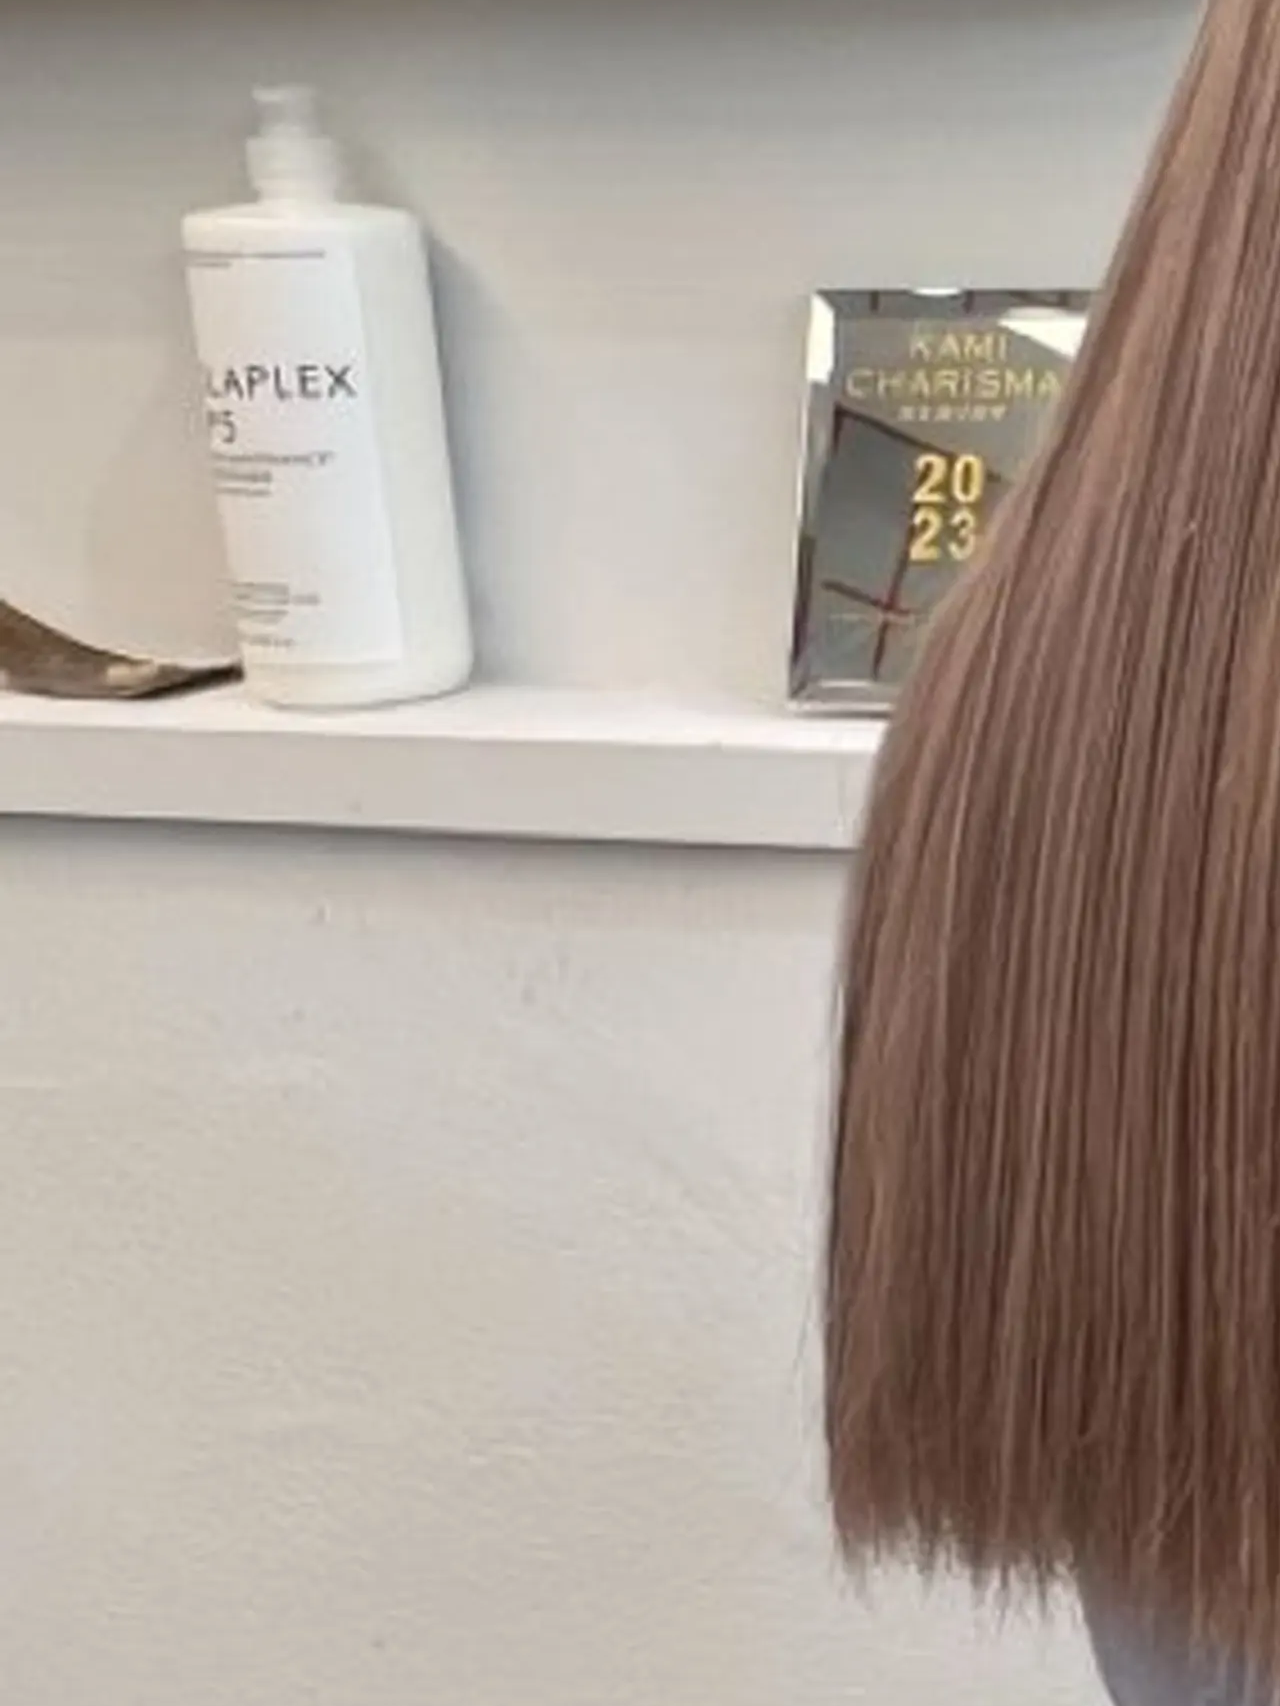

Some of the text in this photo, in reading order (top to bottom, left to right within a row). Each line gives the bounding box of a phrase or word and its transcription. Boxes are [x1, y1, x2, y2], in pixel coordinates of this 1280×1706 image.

[845, 366, 1063, 400] CHARISMA
[911, 453, 986, 505] 20
[908, 511, 978, 562] 23
